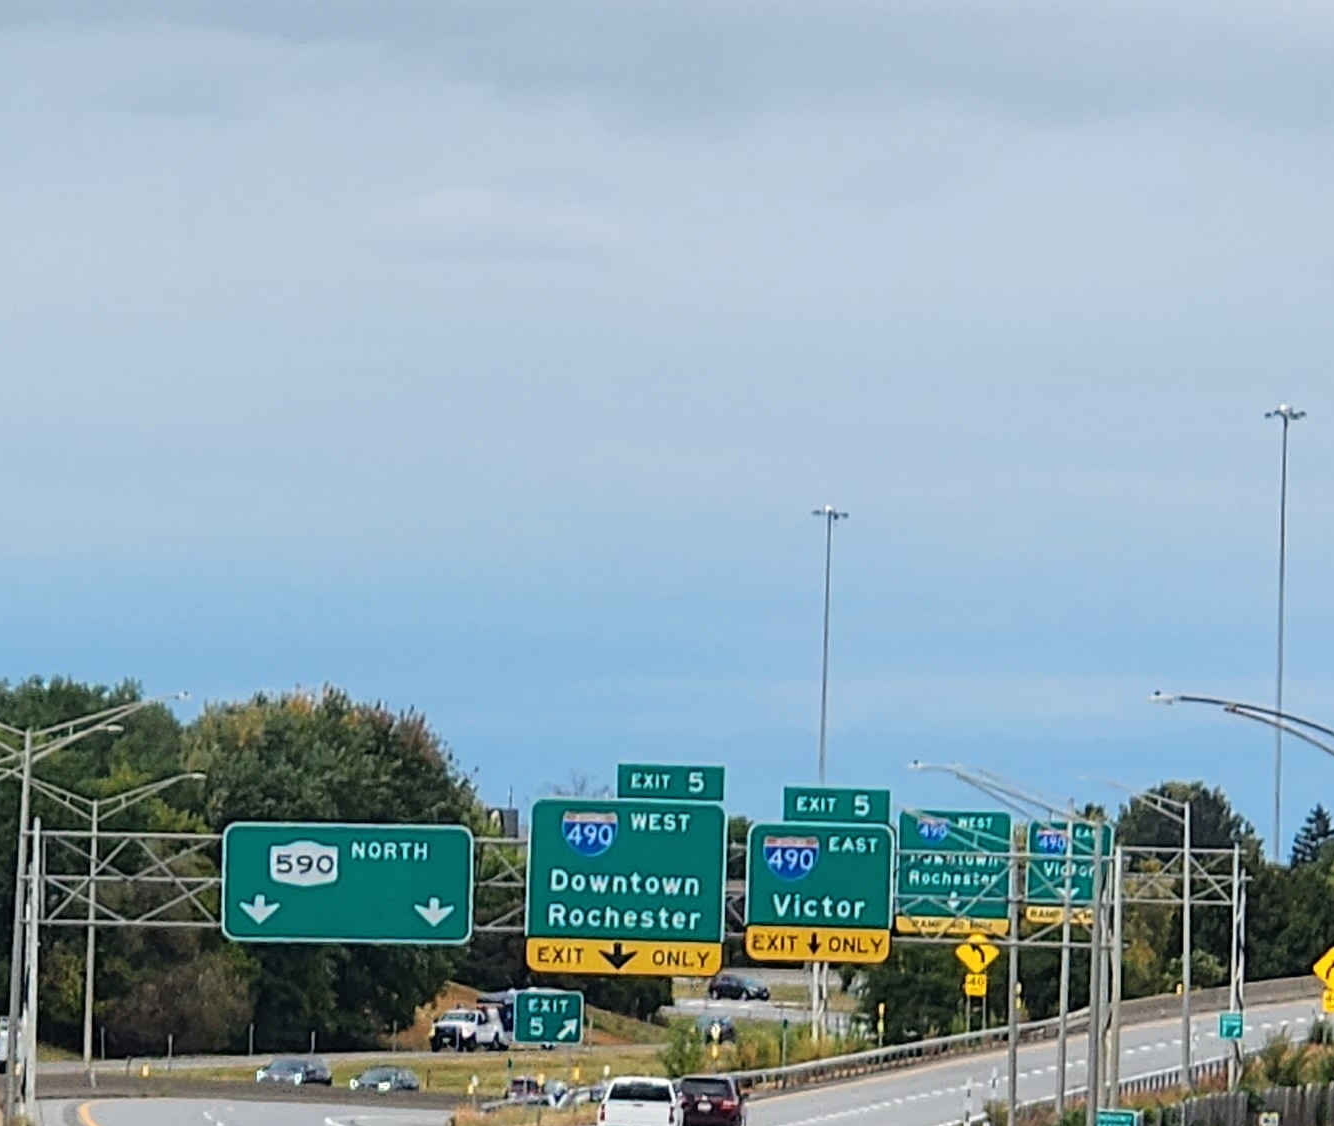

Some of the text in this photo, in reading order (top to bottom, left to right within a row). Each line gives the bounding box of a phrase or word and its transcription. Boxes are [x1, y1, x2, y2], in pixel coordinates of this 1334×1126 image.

[630, 771, 705, 793] EXIT 5
[796, 794, 870, 817] EXIT 5
[568, 812, 691, 847] 490 WEST
[918, 816, 994, 839] 490 WEST
[276, 841, 429, 875] 590 NORTH
[768, 836, 879, 872] 490 EAST
[550, 867, 700, 898] Downtown
[548, 902, 702, 931] Rochester
[772, 893, 866, 920] Victor
[752, 934, 884, 954] EXIT ONLY
[536, 944, 710, 969] EXIT ONLY
[967, 976, 985, 987] 40
[528, 997, 569, 1014] EXIT
[530, 1016, 544, 1036] 5
